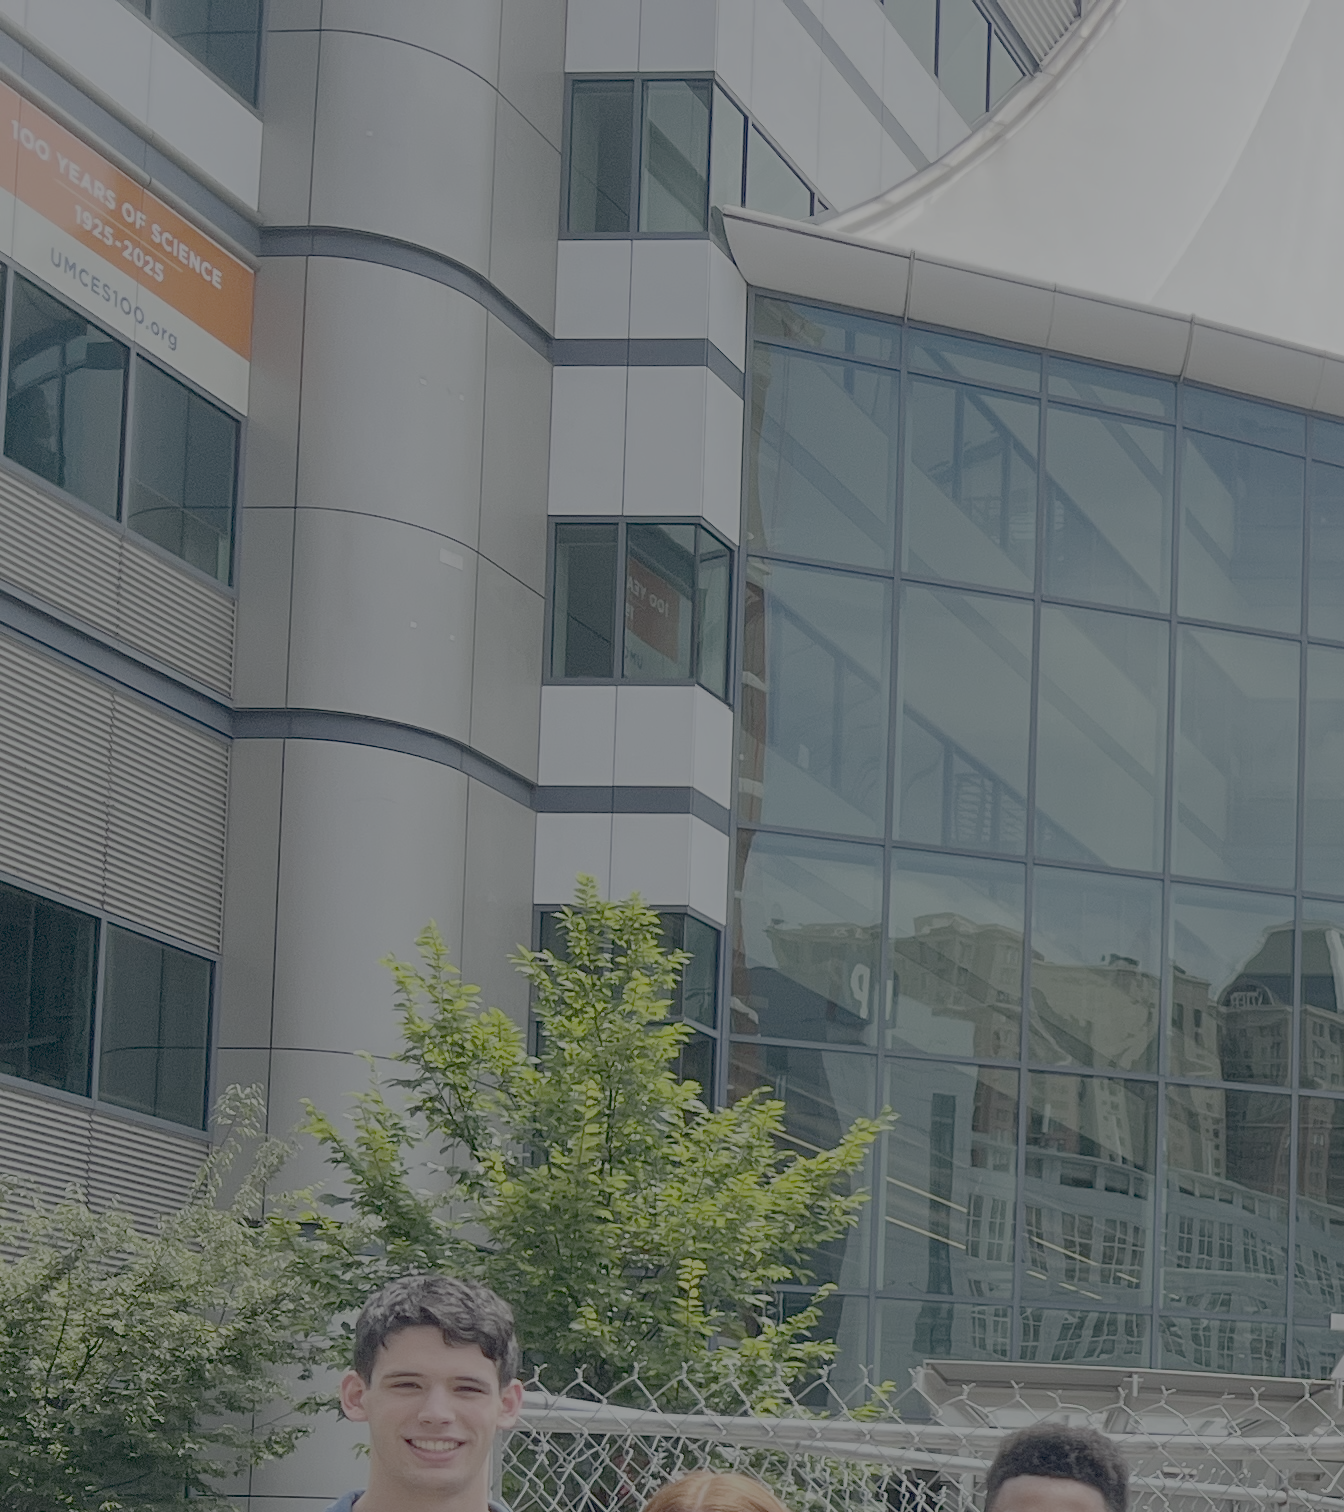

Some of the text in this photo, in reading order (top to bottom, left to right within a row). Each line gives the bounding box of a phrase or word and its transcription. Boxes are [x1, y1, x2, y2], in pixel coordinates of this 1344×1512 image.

[11, 119, 223, 289] 100 YEARS OF SCIENCE
[74, 205, 165, 283] 1925-2025
[50, 247, 178, 352] UMCES100.org
